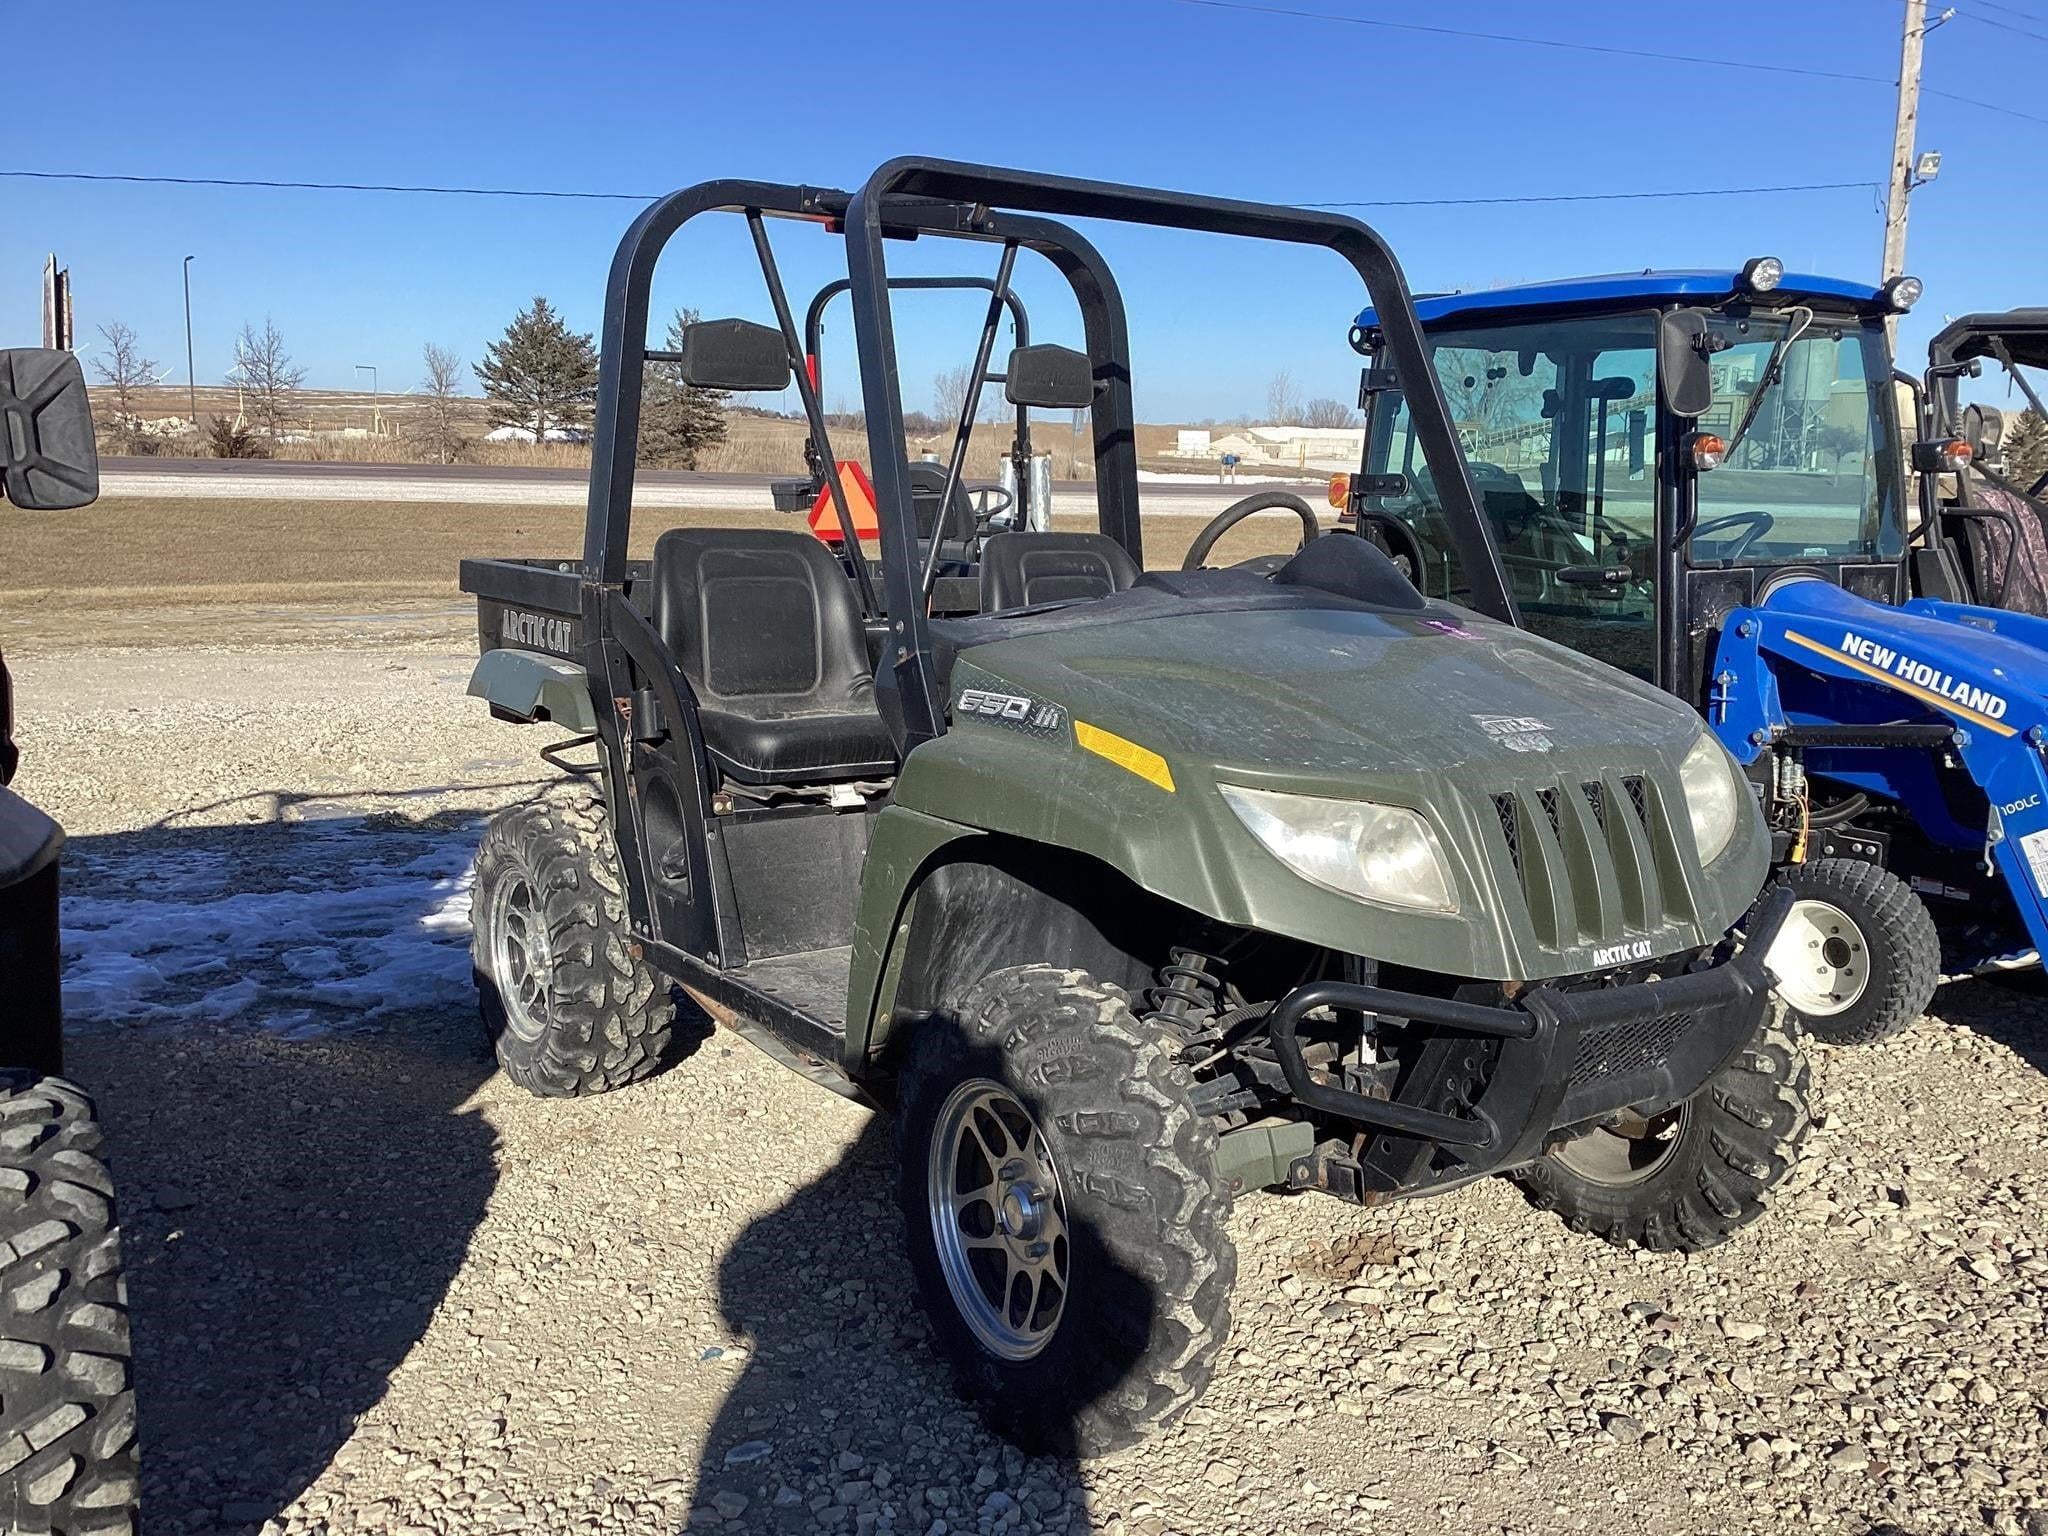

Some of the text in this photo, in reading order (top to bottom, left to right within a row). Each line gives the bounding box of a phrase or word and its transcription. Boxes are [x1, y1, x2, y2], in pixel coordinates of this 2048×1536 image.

[503, 608, 571, 653] ARCTIC CAT
[1841, 632, 2008, 719] NEW HOLLAND
[958, 689, 1031, 720] 650
[2001, 794, 2040, 816] 100LC
[1593, 940, 1652, 967] ARCTIC CAT
